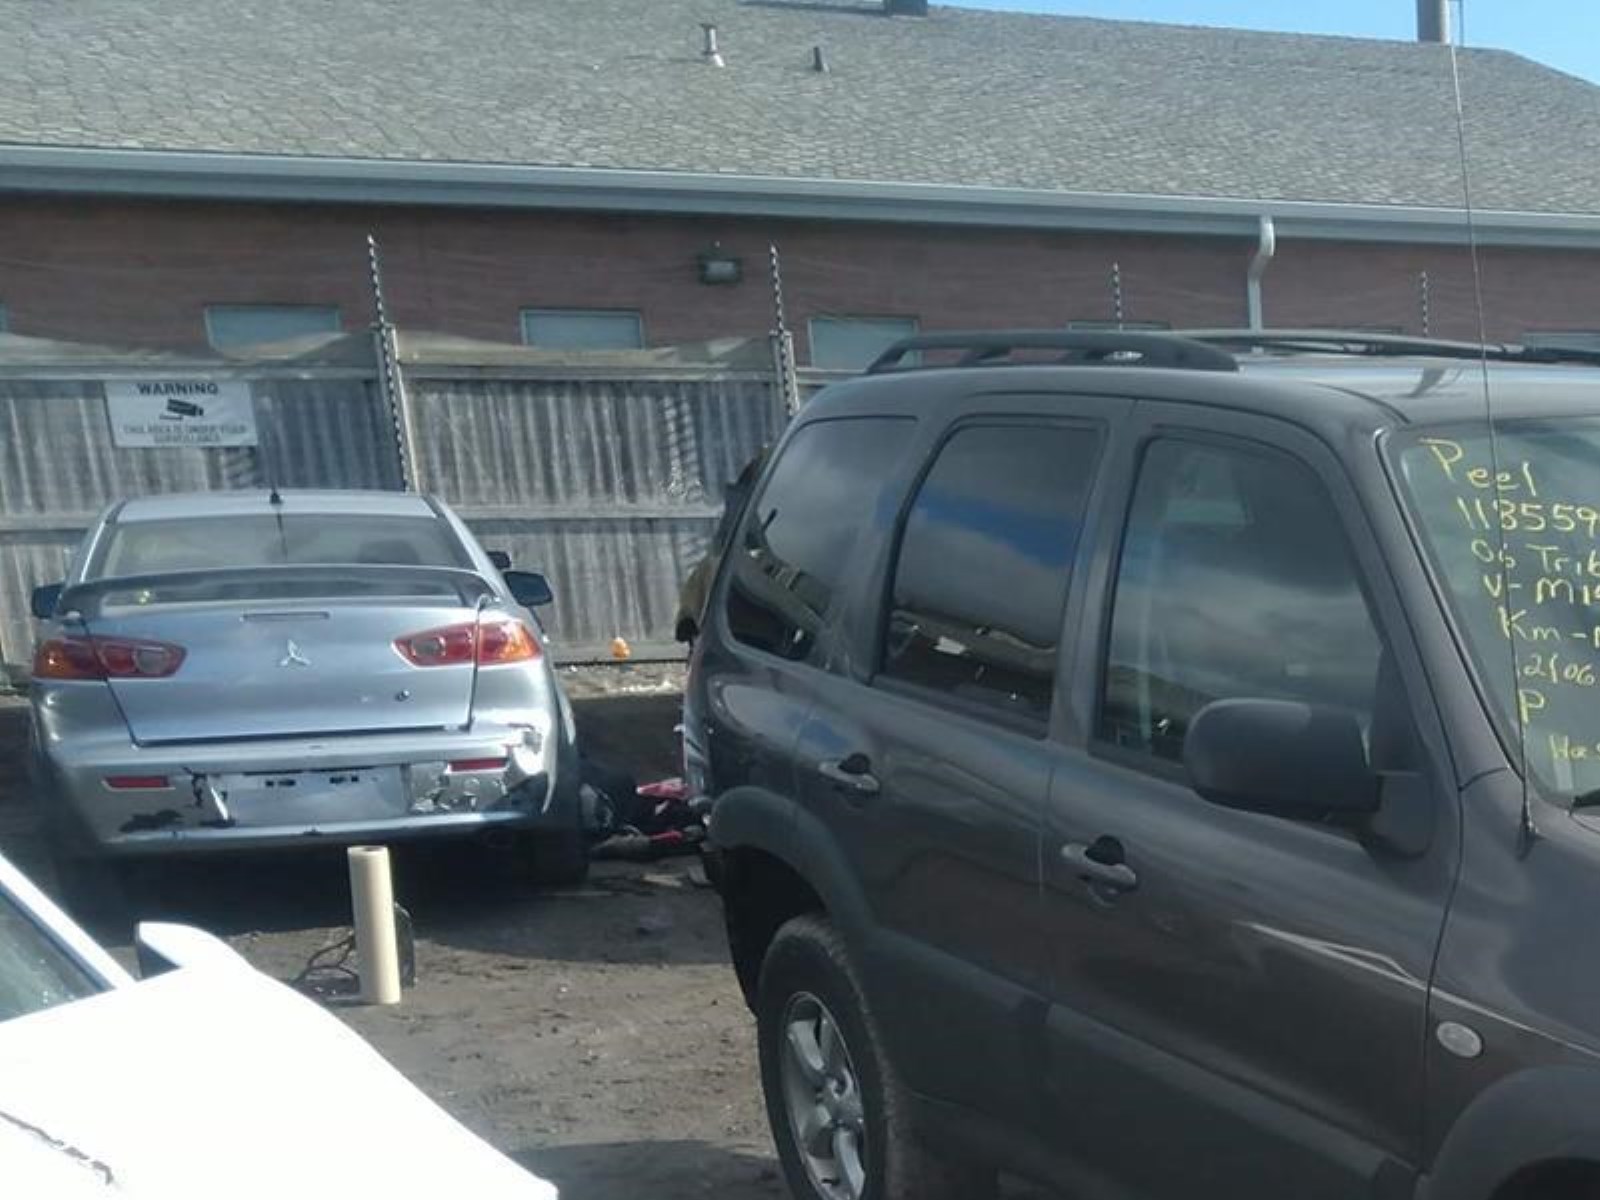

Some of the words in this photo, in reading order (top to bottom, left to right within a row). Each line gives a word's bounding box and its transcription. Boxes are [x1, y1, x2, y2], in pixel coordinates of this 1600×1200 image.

[137, 383, 218, 395] WARNING
[1419, 437, 1537, 496] Peel
[1518, 689, 1544, 723] P
